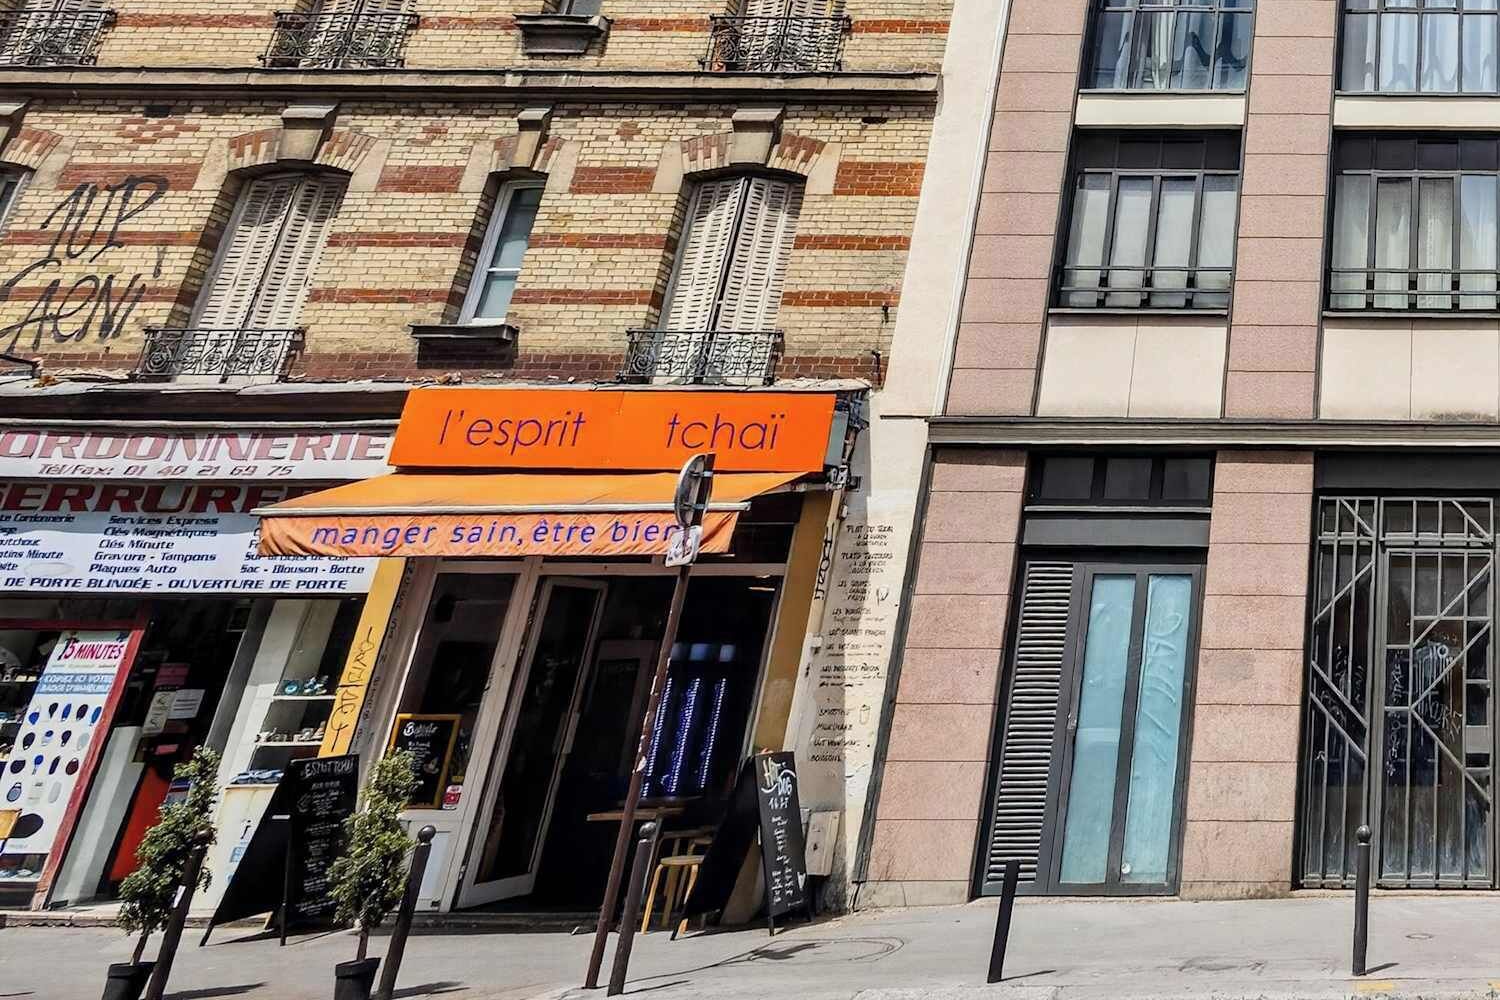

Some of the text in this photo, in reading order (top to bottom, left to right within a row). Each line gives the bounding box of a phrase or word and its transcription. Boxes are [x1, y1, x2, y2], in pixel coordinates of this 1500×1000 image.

[439, 408, 786, 456] l'esprit tchaï
[0, 431, 386, 462] ORDONNERIE
[0, 483, 300, 513] ERRURE
[108, 515, 219, 527] Services Express
[104, 526, 218, 539] Clés Magnétiques
[312, 525, 437, 549] manger
[450, 521, 524, 547] sain,
[532, 519, 597, 543] être
[99, 538, 175, 550] Clés Minute
[94, 551, 146, 561] Gravure
[161, 552, 217, 563] Tampons
[89, 563, 177, 576] Plaques Auto
[240, 564, 260, 574] Sac
[4, 577, 25, 588] DE
[30, 577, 83, 589] PORTE
[87, 575, 152, 589] BLINDÉE
[168, 579, 264, 590] OUVERTURE
[270, 580, 290, 589] DE
[296, 580, 348, 589] PORTE
[74, 643, 124, 660] MINUTES
